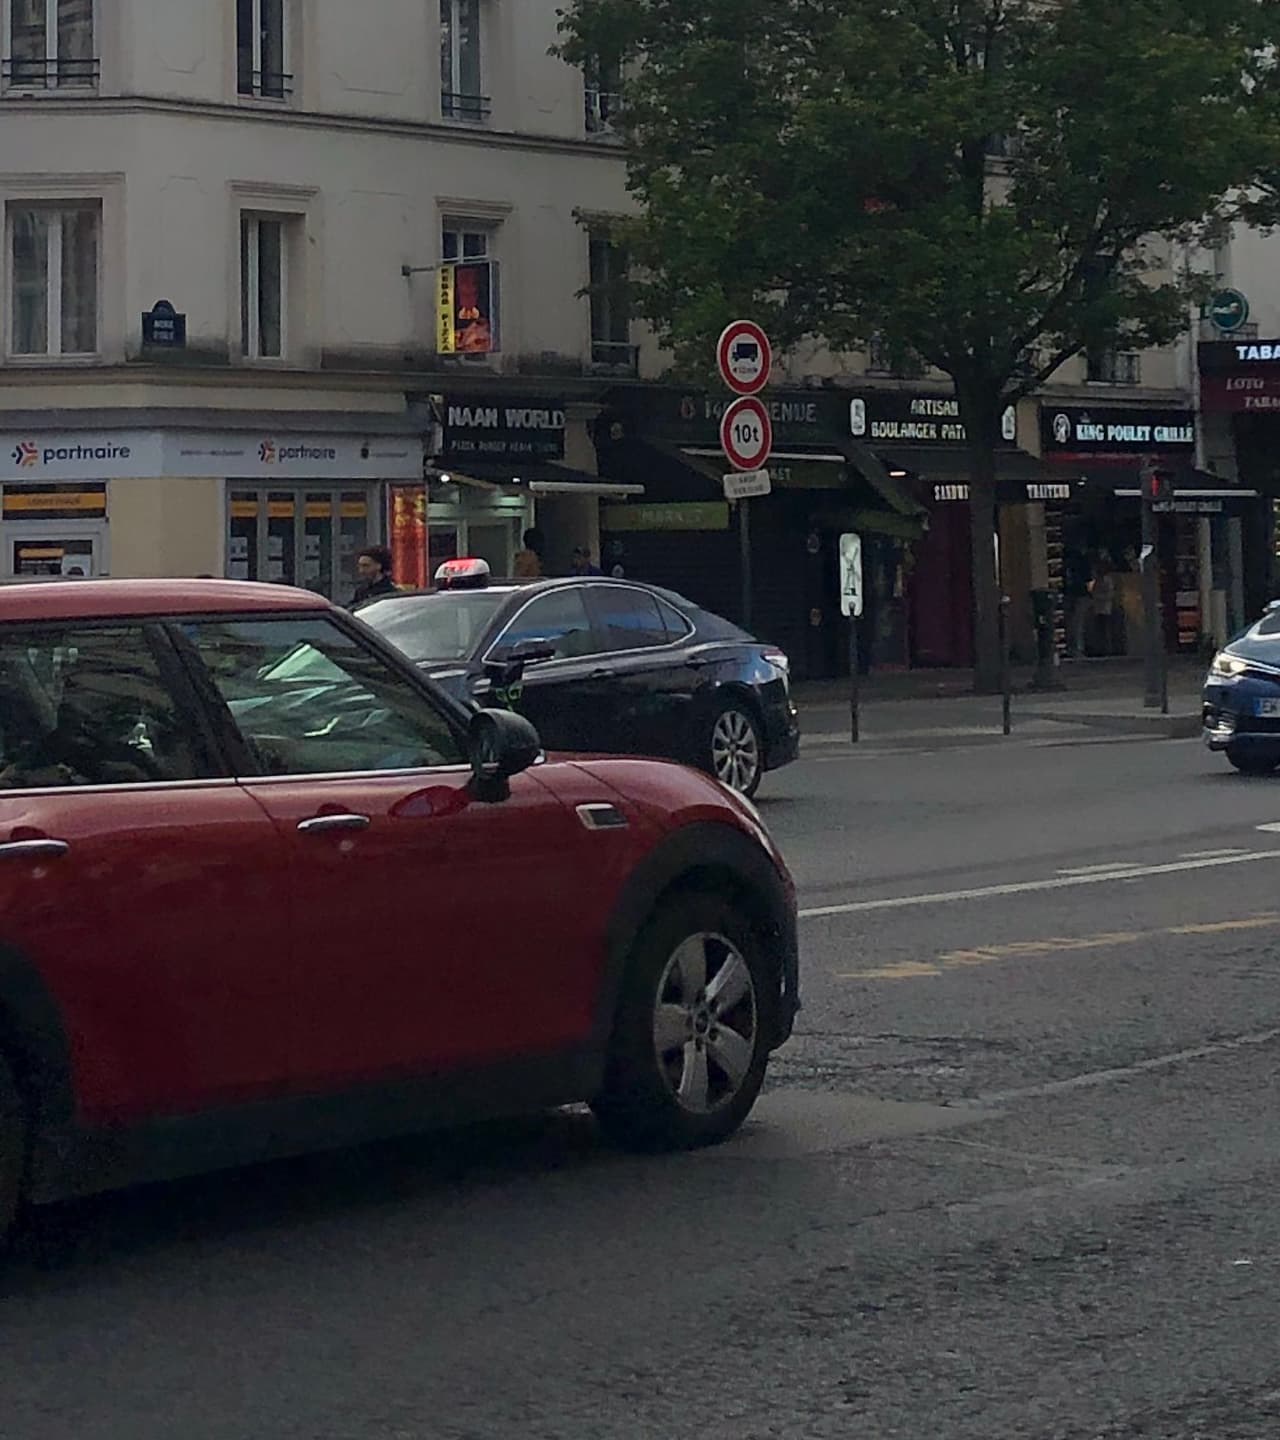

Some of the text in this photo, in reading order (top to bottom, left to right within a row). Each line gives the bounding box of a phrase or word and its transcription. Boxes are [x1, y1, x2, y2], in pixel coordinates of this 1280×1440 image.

[441, 313, 450, 351] PIZZA
[910, 399, 959, 417] ARTISAN
[448, 406, 565, 429] NAAN WORLD
[734, 424, 760, 443] 10t
[871, 422, 937, 439] BOULANGER
[1076, 424, 1104, 441] KING
[1108, 425, 1151, 442] POULET
[43, 442, 131, 464] partnaire
[279, 445, 336, 463] partnaire
